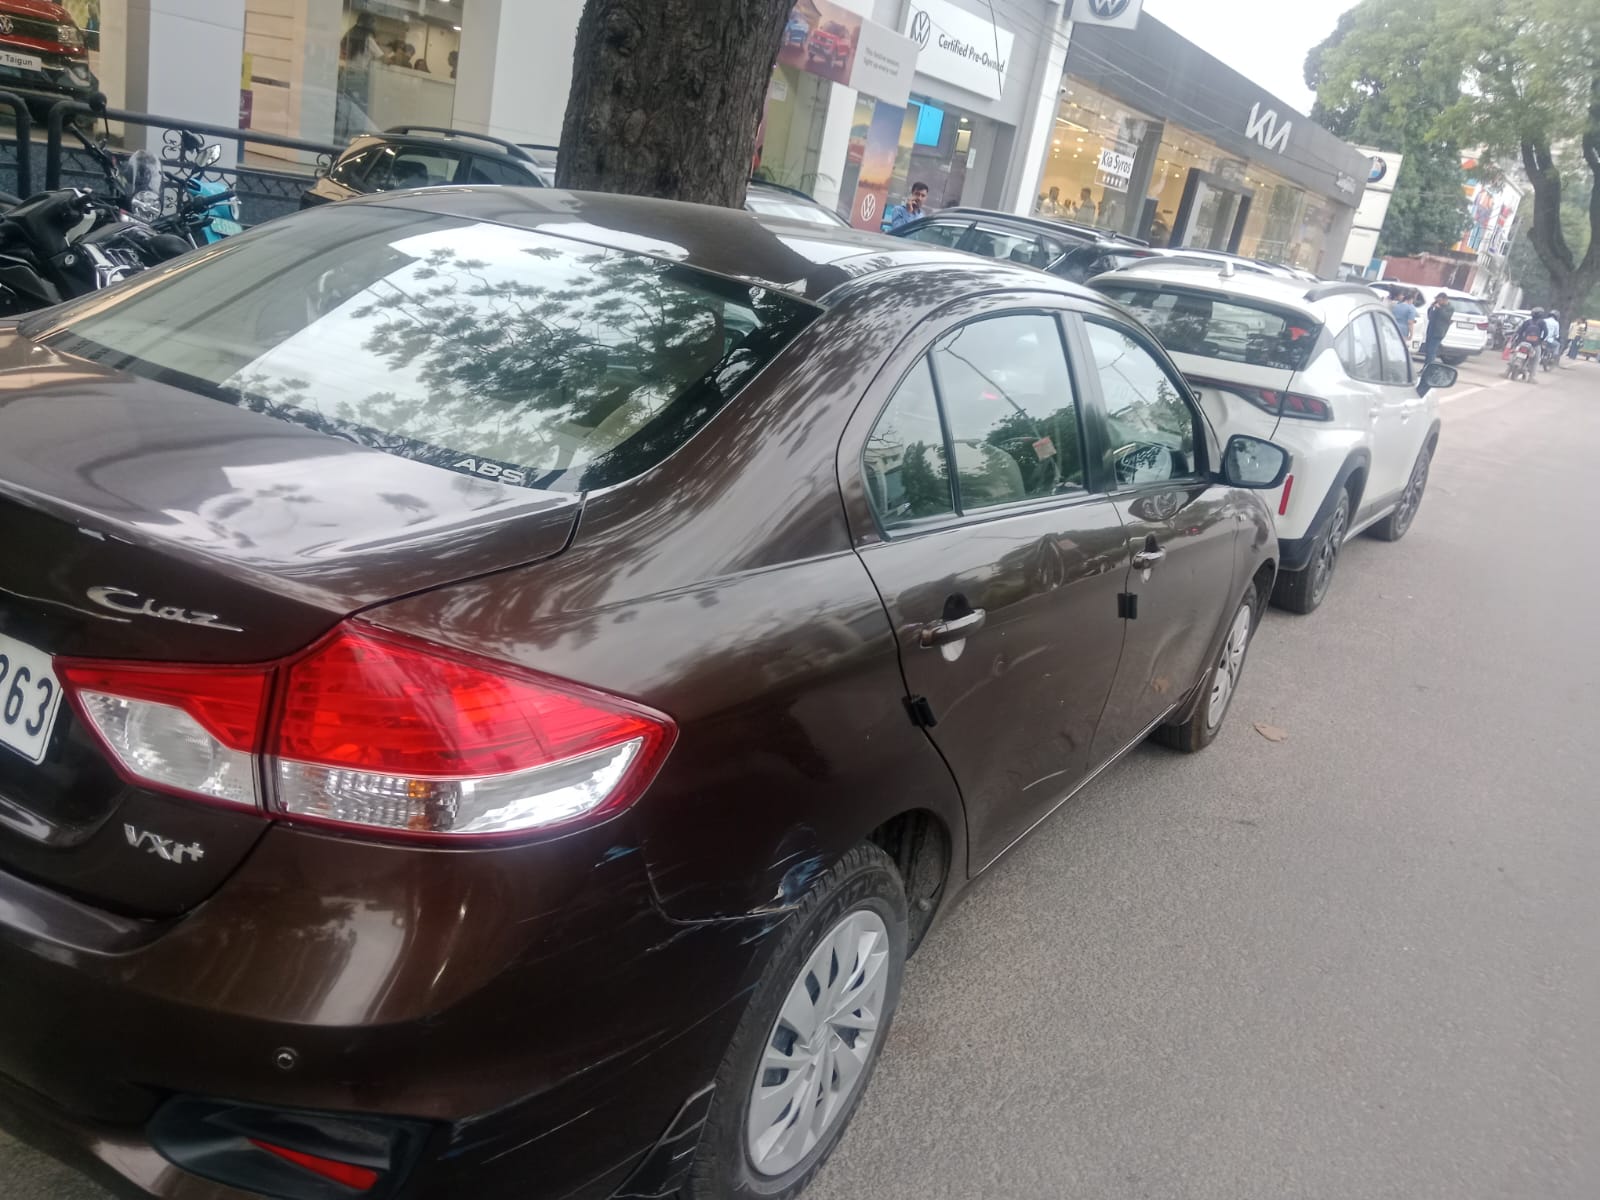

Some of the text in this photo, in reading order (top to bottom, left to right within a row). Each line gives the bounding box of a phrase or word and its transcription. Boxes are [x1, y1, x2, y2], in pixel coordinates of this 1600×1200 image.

[938, 33, 969, 58] Certified
[5, 54, 33, 66] Taigun
[1101, 151, 1132, 175] Kia Syros
[452, 458, 525, 483] ABS
[86, 585, 244, 632] Ciaz
